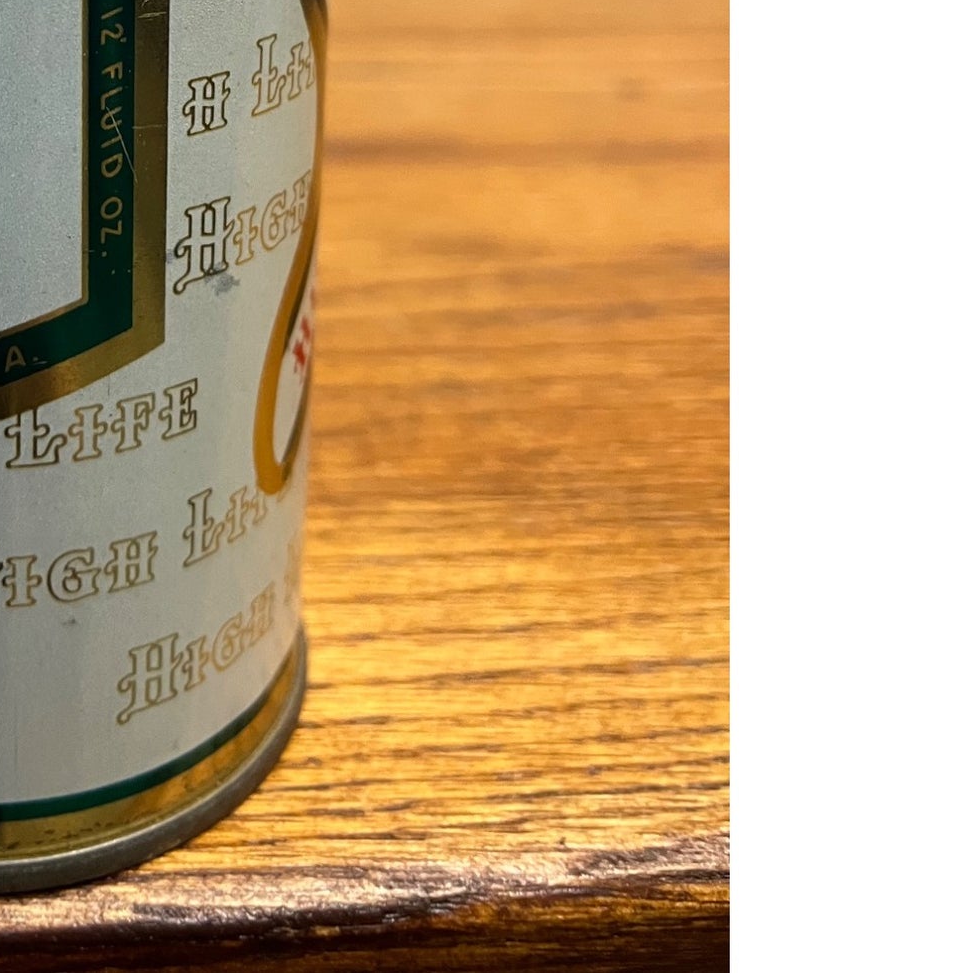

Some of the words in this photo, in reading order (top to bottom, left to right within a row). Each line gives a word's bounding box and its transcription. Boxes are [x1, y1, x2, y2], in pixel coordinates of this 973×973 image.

[100, 6, 127, 46] 12
[100, 61, 124, 178] FLUID
[5, 378, 199, 470] LIFE
[115, 580, 276, 726] HIGH
